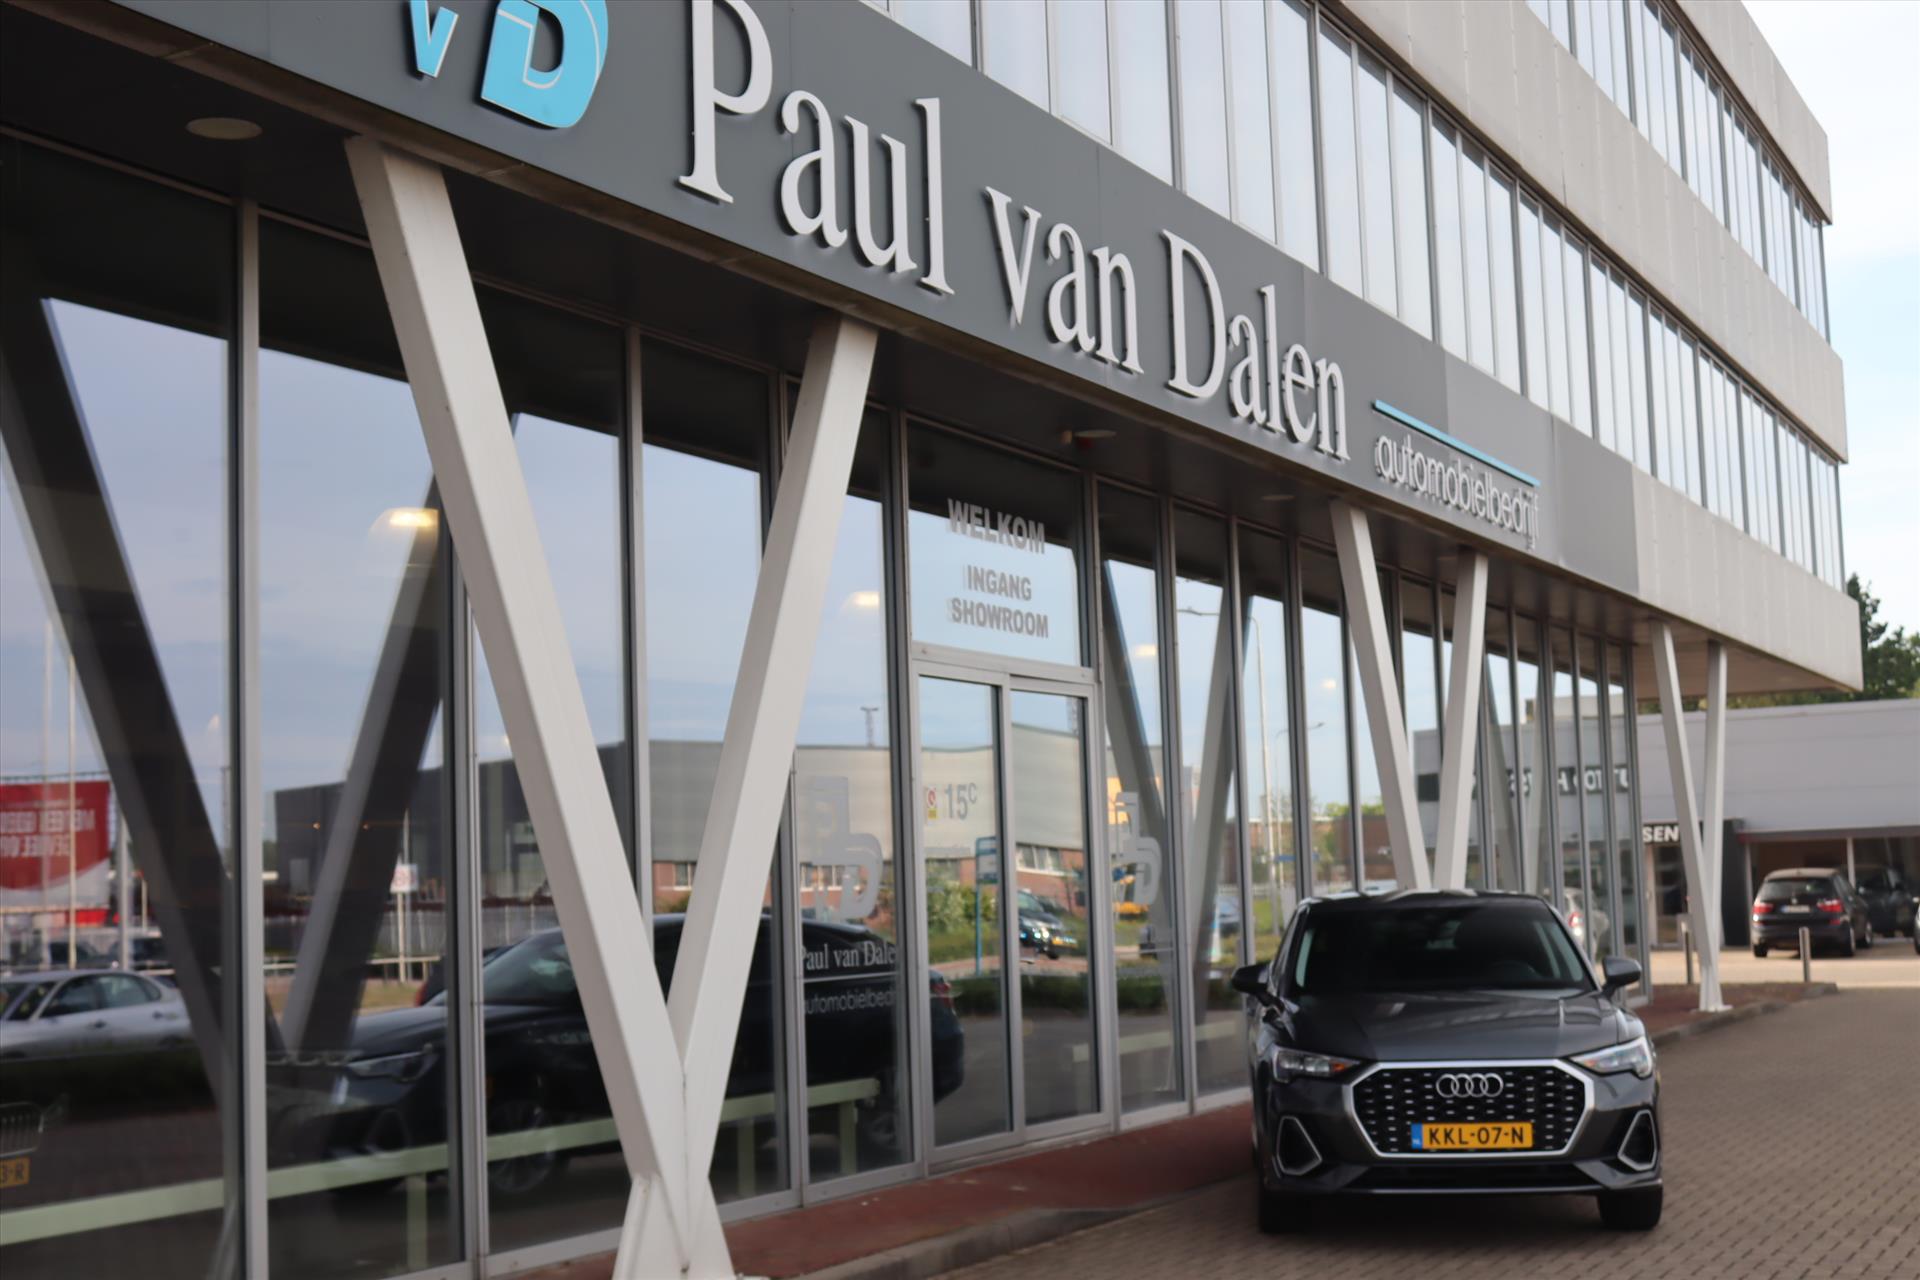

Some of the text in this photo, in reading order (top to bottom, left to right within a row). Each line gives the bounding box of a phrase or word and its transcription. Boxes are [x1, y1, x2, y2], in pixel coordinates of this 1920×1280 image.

[678, 0, 1351, 461] Paul van Dalen
[1376, 434, 1539, 549] automobielbedrijf
[948, 498, 1046, 554] WELKOM
[967, 565, 1032, 601] INGANG
[950, 597, 1049, 638] SHOWROOM
[833, 948, 859, 968] van
[863, 940, 898, 966] Dale
[1428, 1126, 1525, 1146] KKL-07-N
